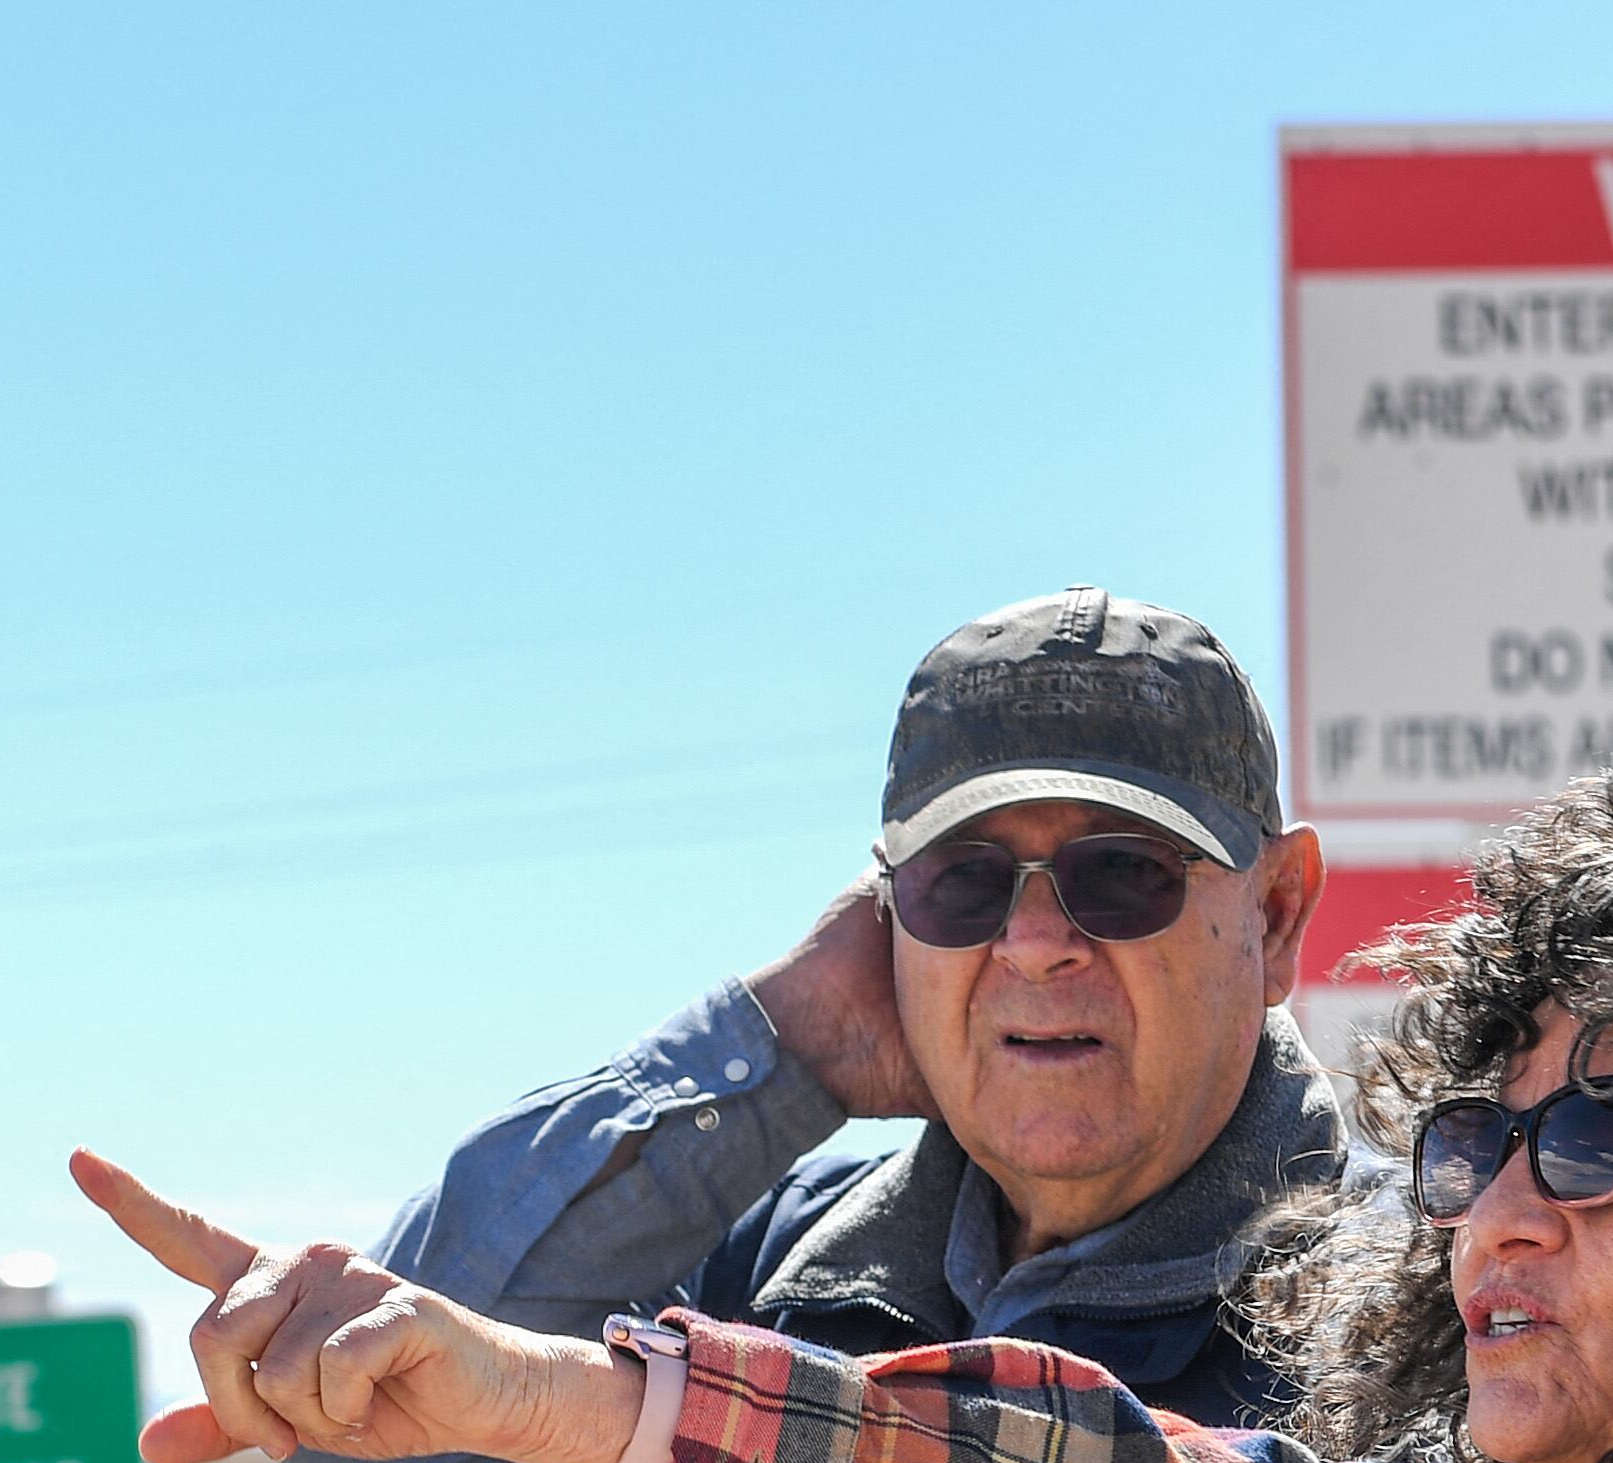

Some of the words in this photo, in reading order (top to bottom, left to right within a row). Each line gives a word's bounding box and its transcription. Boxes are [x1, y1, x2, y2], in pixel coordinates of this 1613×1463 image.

[1354, 375, 1568, 443] AREAS
[1488, 627, 1586, 696] DO
[1315, 714, 1366, 783] IF
[1380, 713, 1556, 782] ITEMS
